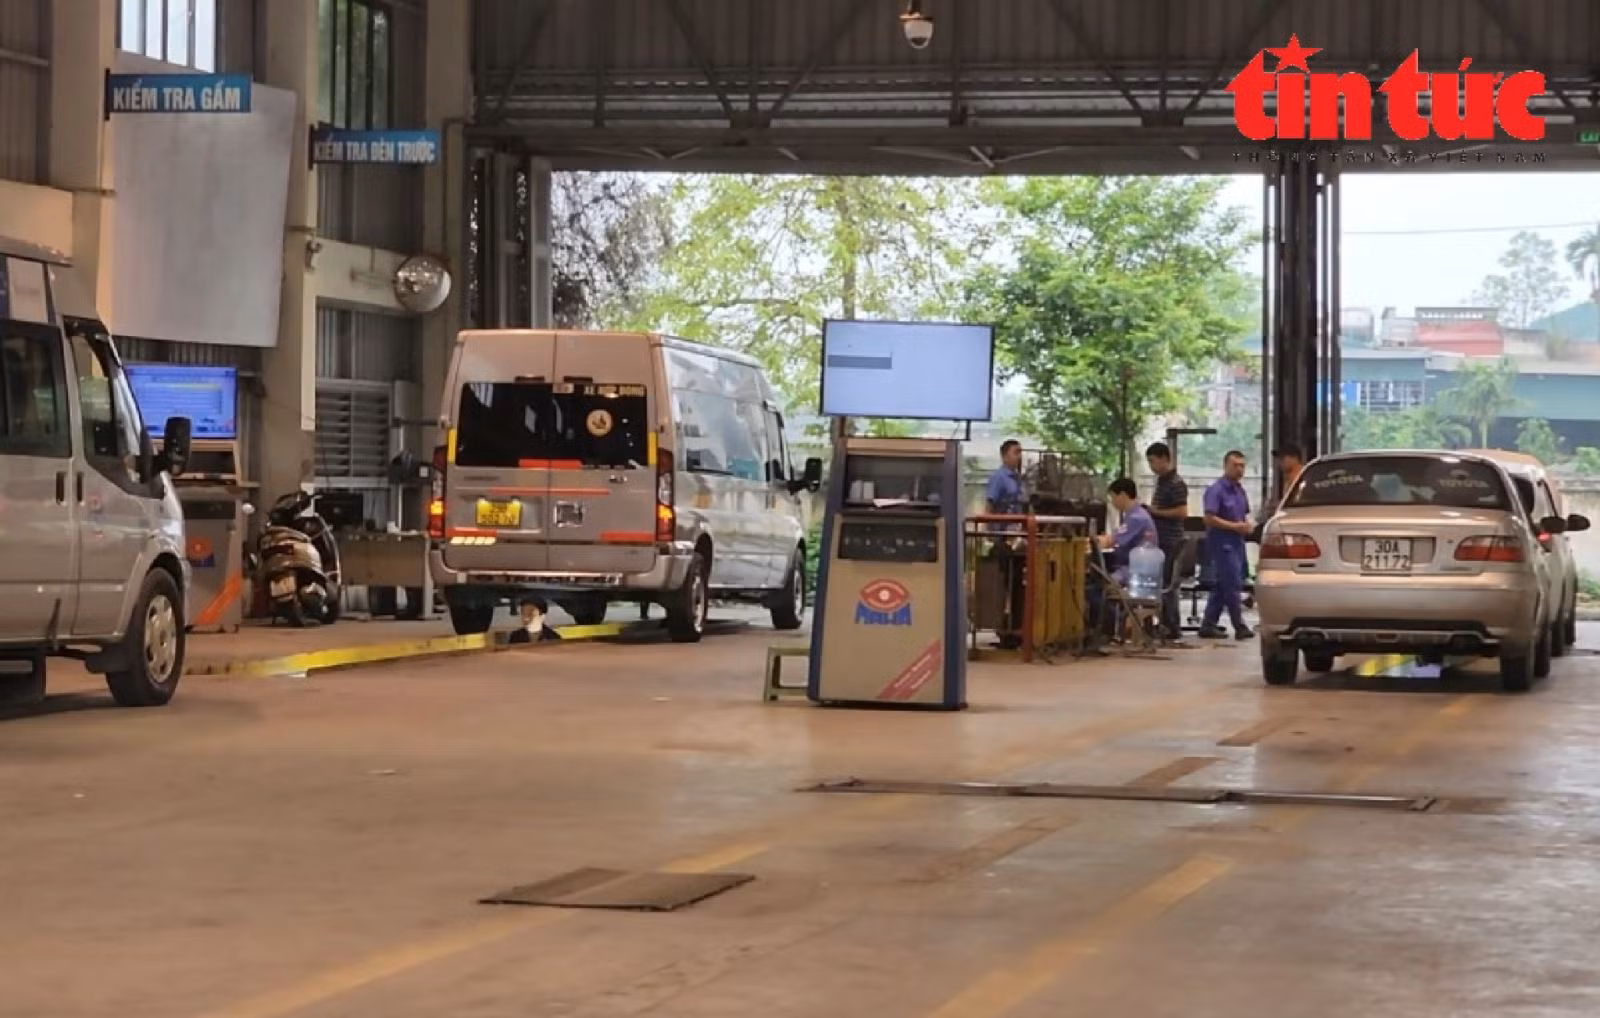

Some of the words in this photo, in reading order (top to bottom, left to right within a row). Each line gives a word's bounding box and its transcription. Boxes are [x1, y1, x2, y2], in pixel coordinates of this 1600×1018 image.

[163, 87, 196, 111] TRA
[346, 141, 369, 161] TRA
[1314, 474, 1364, 489] TOYOTA
[1438, 479, 1490, 489] TOYOTA
[1374, 539, 1400, 554] 30A
[1364, 555, 1411, 570] 21172
